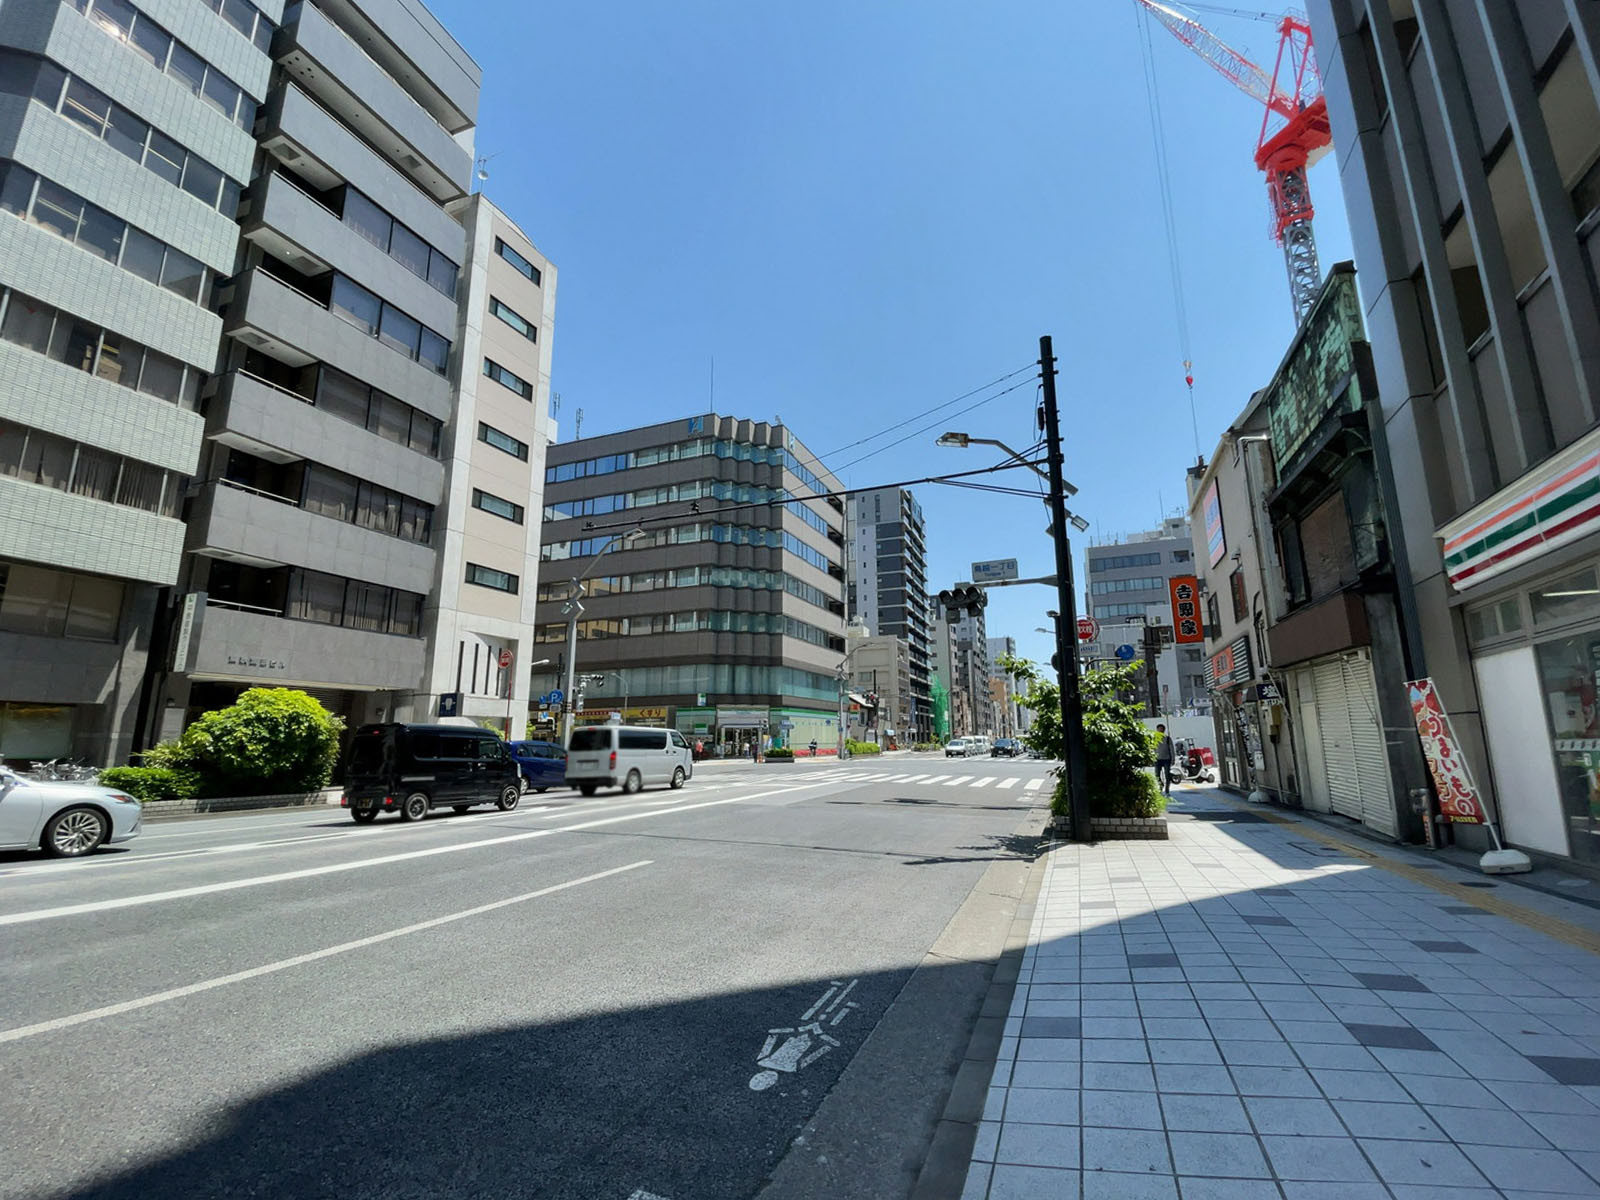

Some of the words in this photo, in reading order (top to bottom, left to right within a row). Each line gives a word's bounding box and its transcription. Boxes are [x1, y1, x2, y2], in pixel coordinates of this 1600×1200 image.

[1176, 584, 1198, 636] 吉野家
[639, 709, 661, 717] くすり
[1428, 708, 1474, 815] うまいもの
